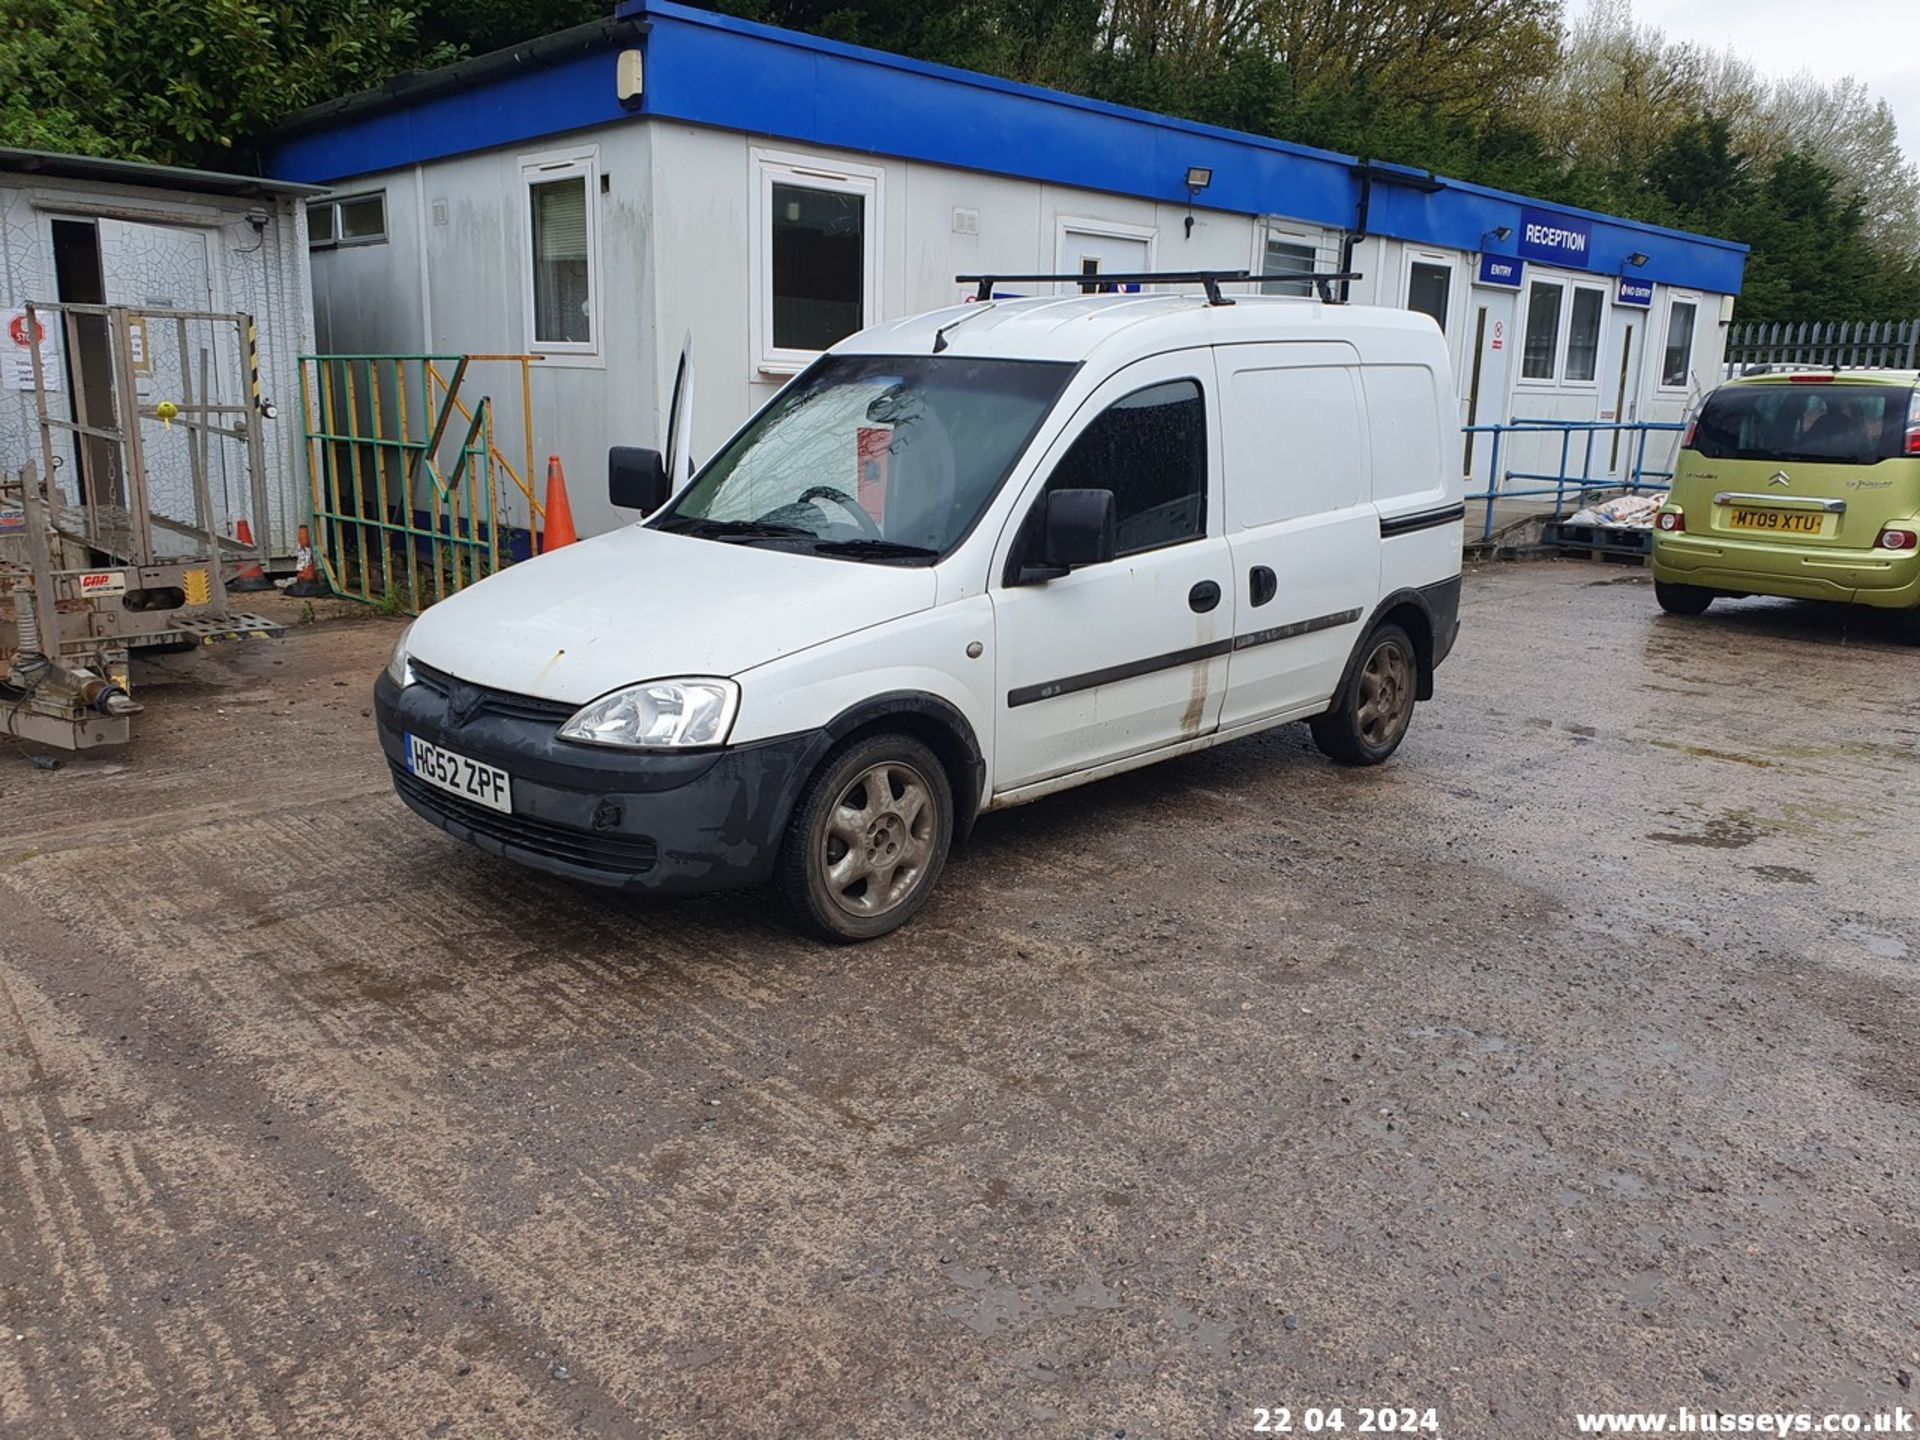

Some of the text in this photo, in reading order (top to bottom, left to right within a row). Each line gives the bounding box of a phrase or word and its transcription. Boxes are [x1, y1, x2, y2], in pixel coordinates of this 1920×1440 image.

[1525, 224, 1586, 252] RECEPTION
[1490, 263, 1513, 277] ENTRY
[1626, 286, 1651, 298] NO ENTRY
[1734, 512, 1816, 531] MT09 XTU
[83, 575, 109, 587] GAP
[413, 740, 505, 803] HG52 ZPF
